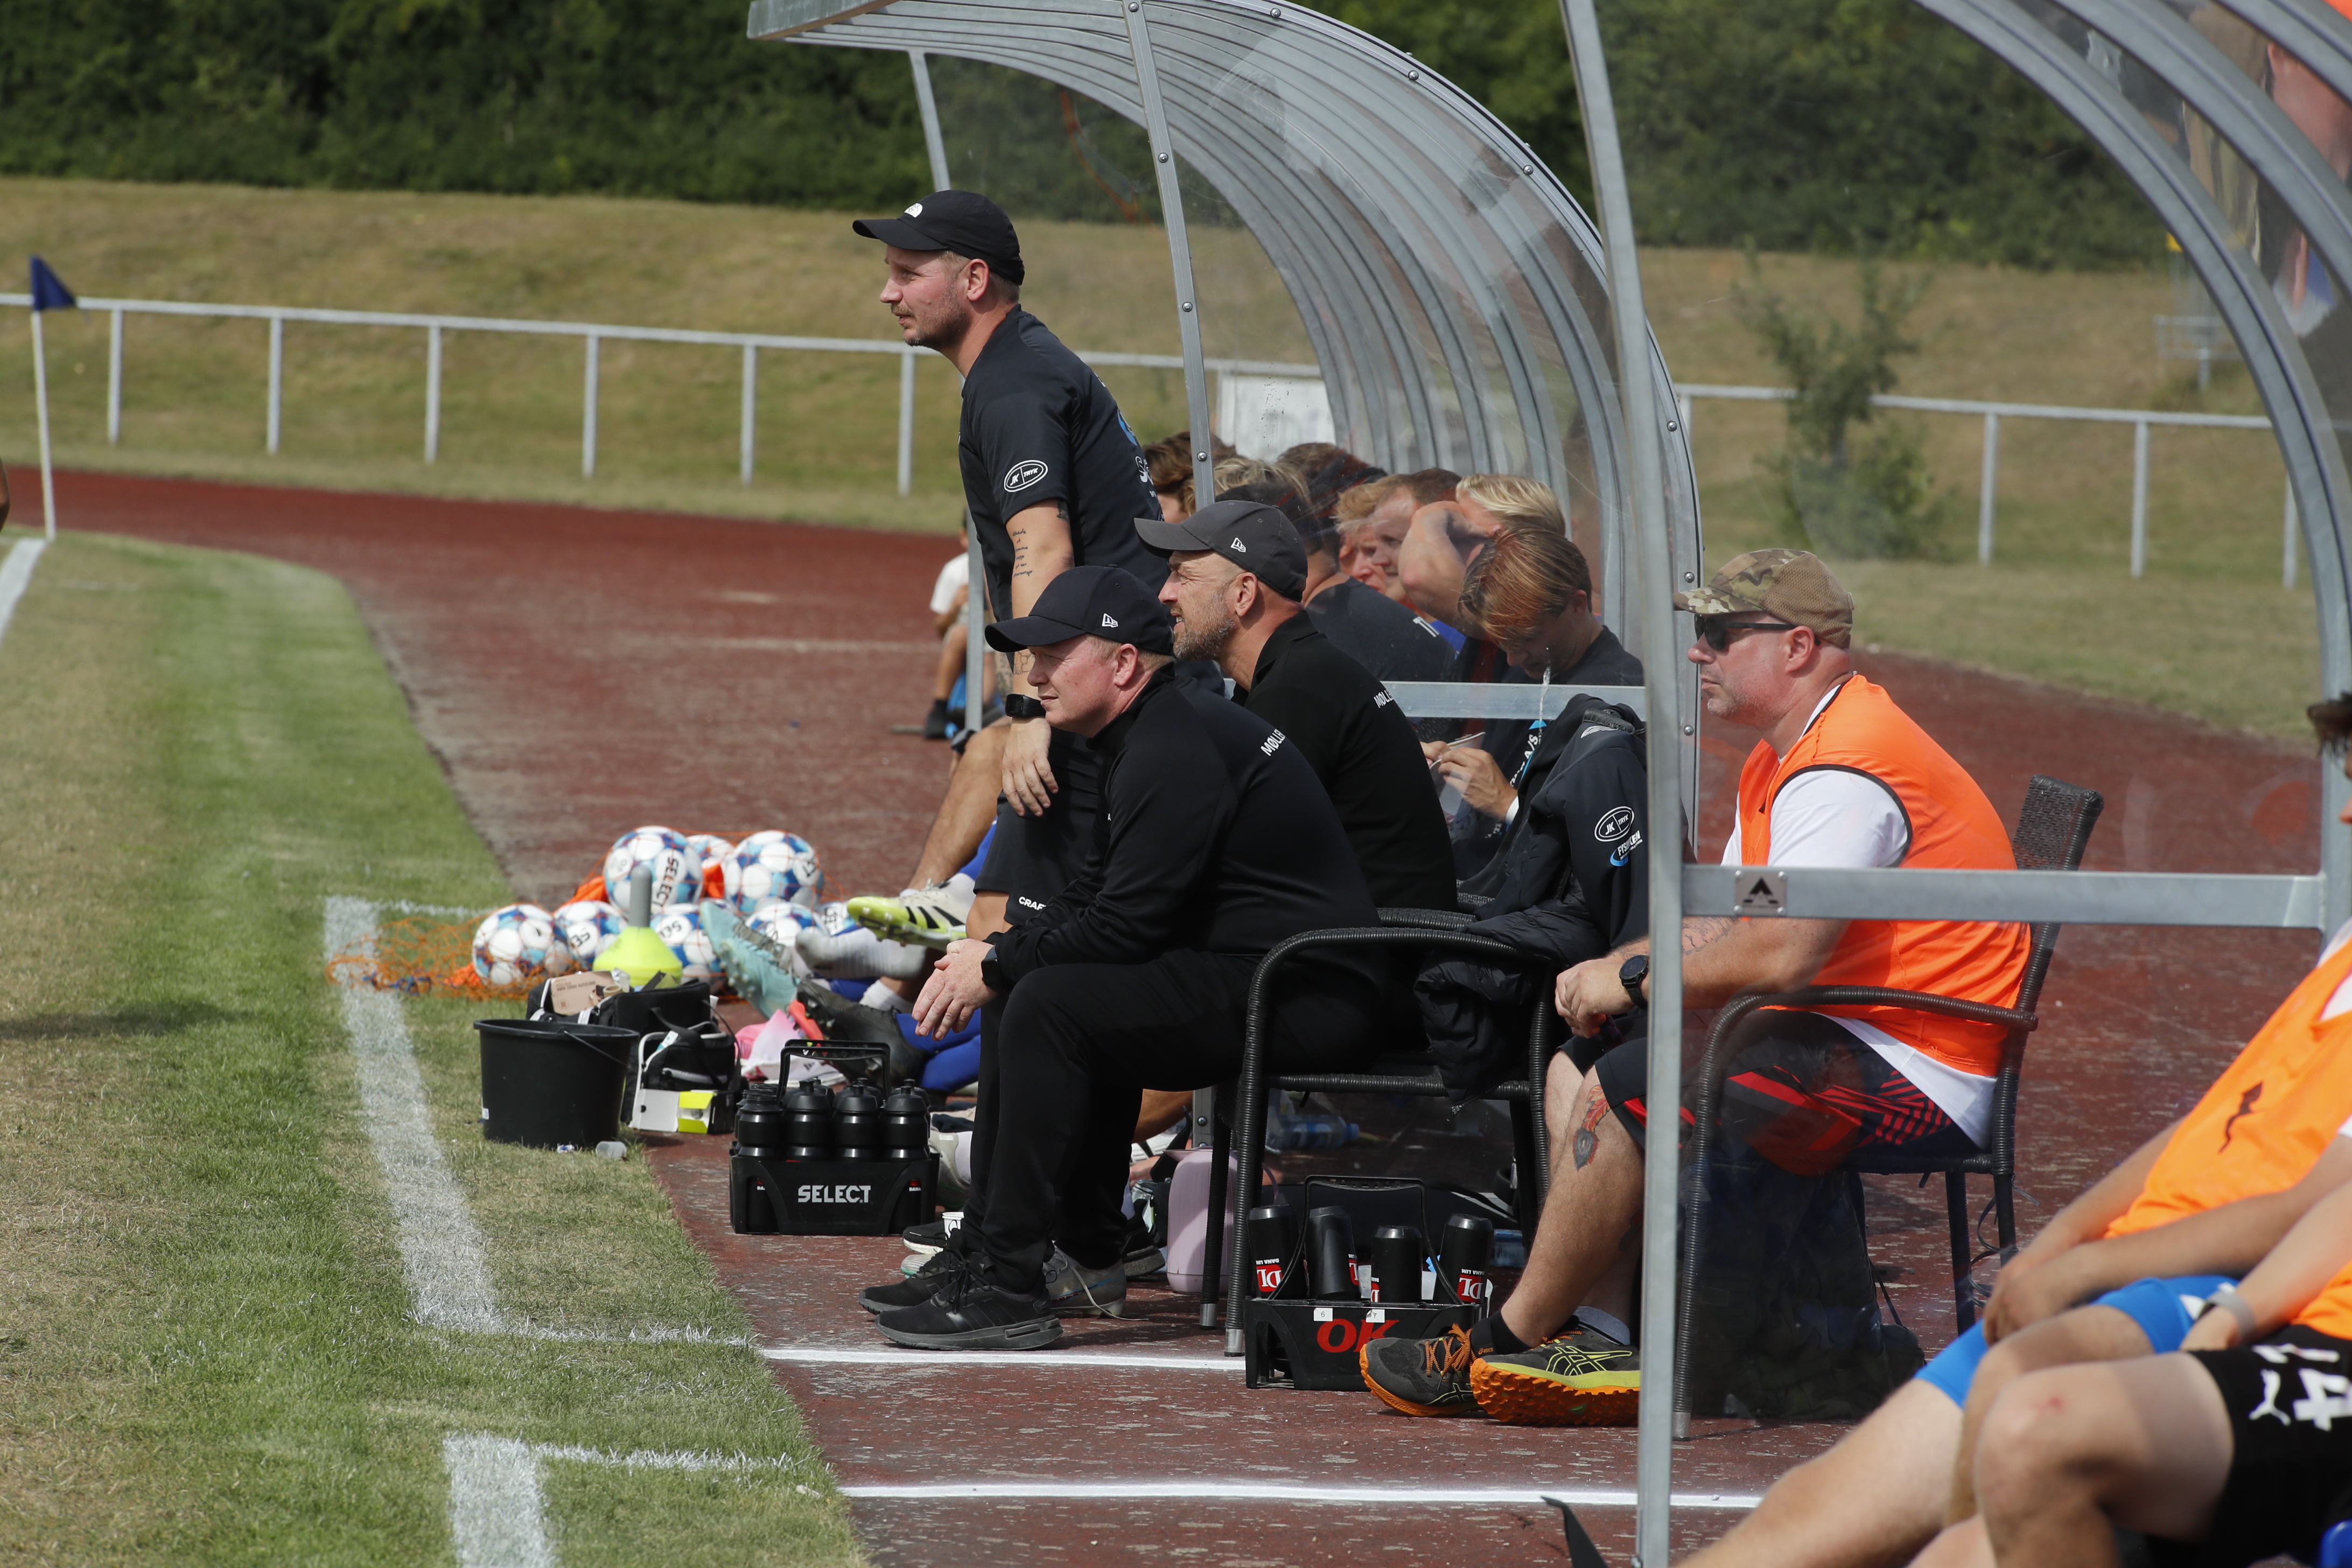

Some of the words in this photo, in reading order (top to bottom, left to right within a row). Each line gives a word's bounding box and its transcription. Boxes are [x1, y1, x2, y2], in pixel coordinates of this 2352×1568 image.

[1010, 473, 1019, 486] JK
[1023, 467, 1039, 478] TRYK
[1605, 821, 1615, 835] JK
[1618, 814, 1629, 825] TRYK
[1018, 896, 1046, 911] CRAF
[797, 1185, 871, 1203] SELECT
[1256, 1269, 1282, 1288] DL
[1459, 1277, 1483, 1299] DL
[1317, 1318, 1399, 1353] OK
